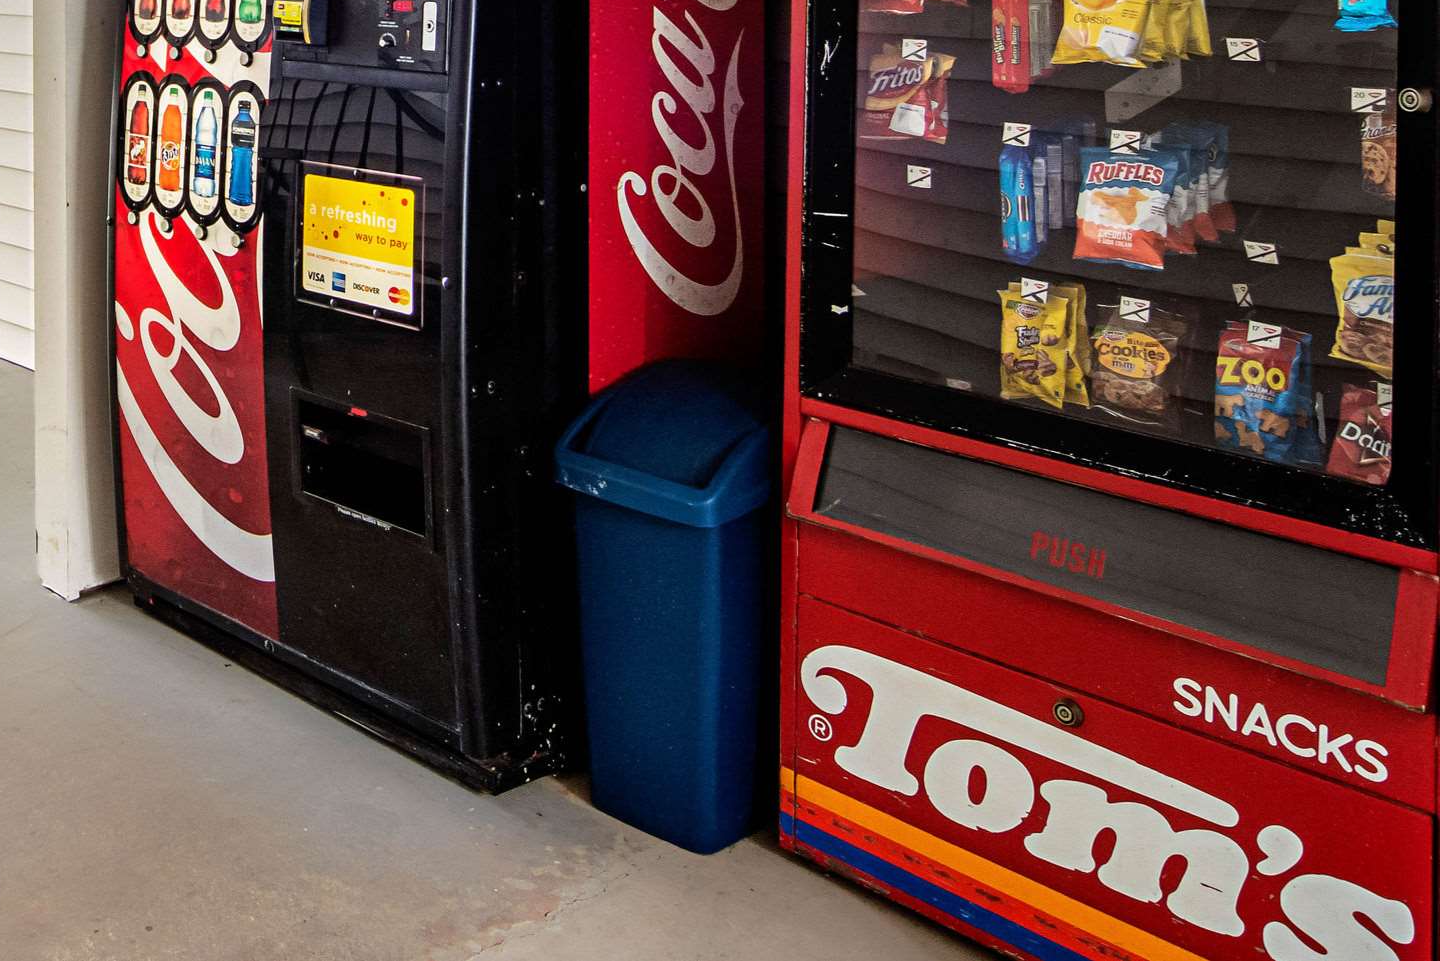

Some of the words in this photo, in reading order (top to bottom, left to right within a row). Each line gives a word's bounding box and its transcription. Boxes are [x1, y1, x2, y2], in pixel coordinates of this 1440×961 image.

[1074, 13, 1112, 24] Classic
[1088, 161, 1164, 185] RUFFLES
[309, 203, 317, 215] a
[321, 205, 397, 233] refreshing
[355, 232, 373, 244] way
[376, 236, 386, 245] to
[389, 239, 408, 250] pay
[308, 271, 325, 283] VISA
[353, 282, 380, 295] DISCOVER
[1099, 343, 1165, 361] Cookies
[1217, 356, 1286, 391] ZOO
[1029, 530, 1107, 579] PUSH
[1173, 677, 1389, 783] SNACKS
[801, 644, 1415, 961] Tom's
